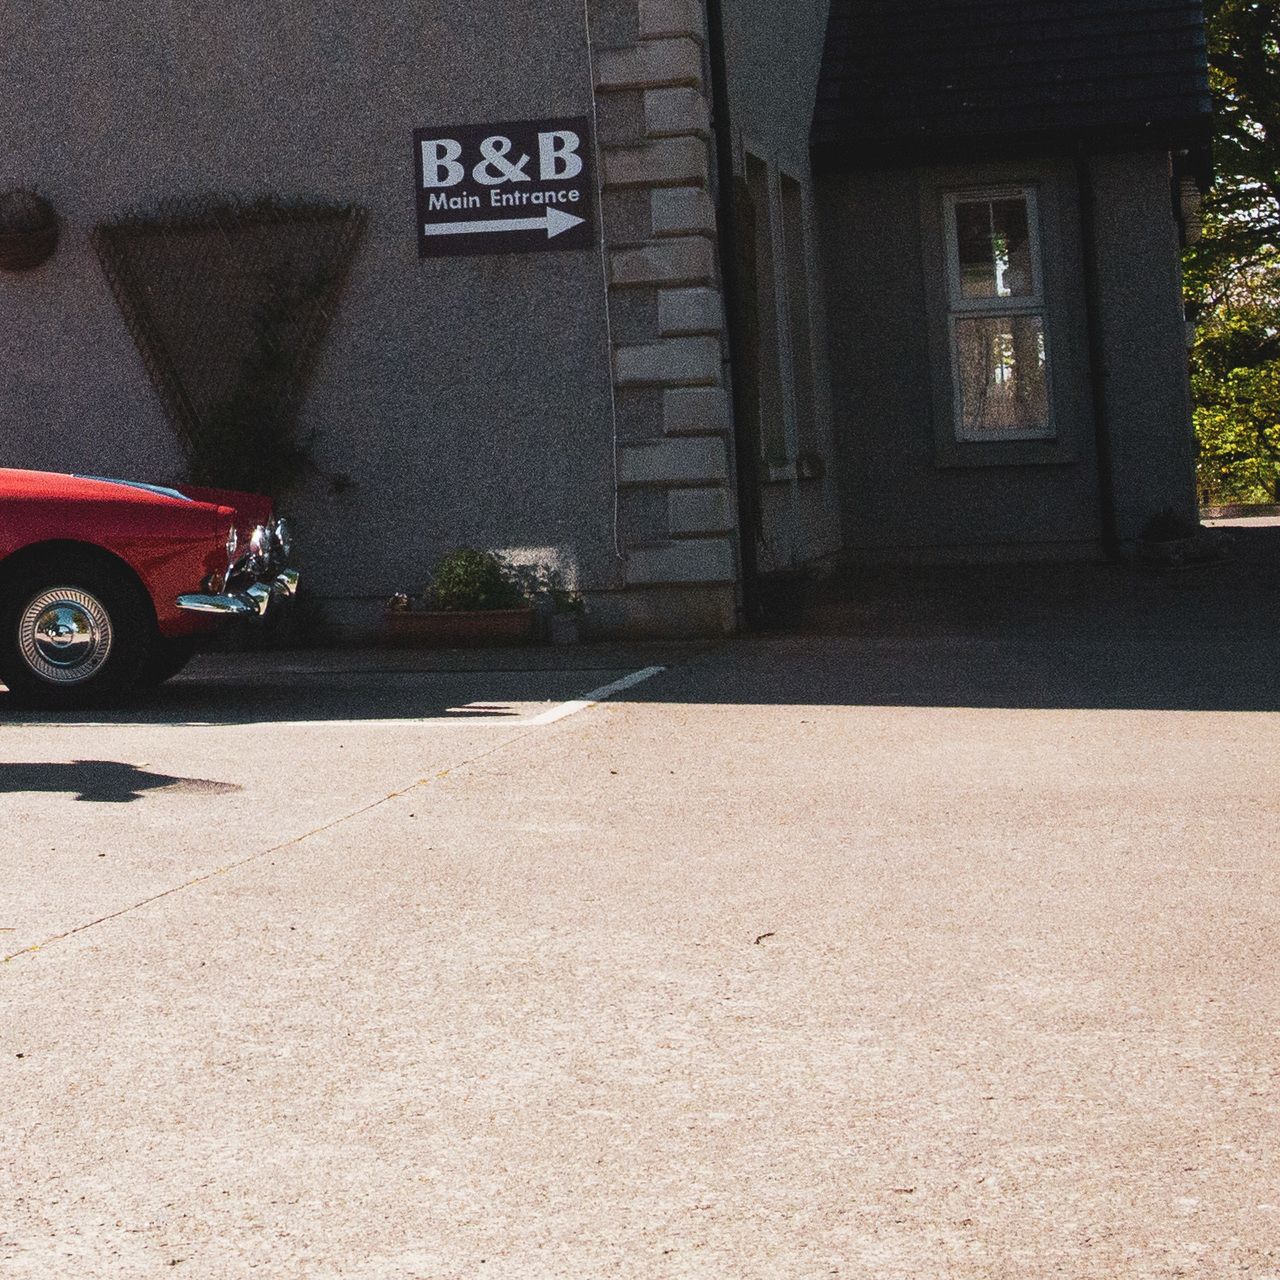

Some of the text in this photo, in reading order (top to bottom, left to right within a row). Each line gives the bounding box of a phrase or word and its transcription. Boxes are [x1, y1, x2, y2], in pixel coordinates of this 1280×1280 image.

[421, 130, 583, 188] B&B
[428, 188, 580, 211] Main Entrance
